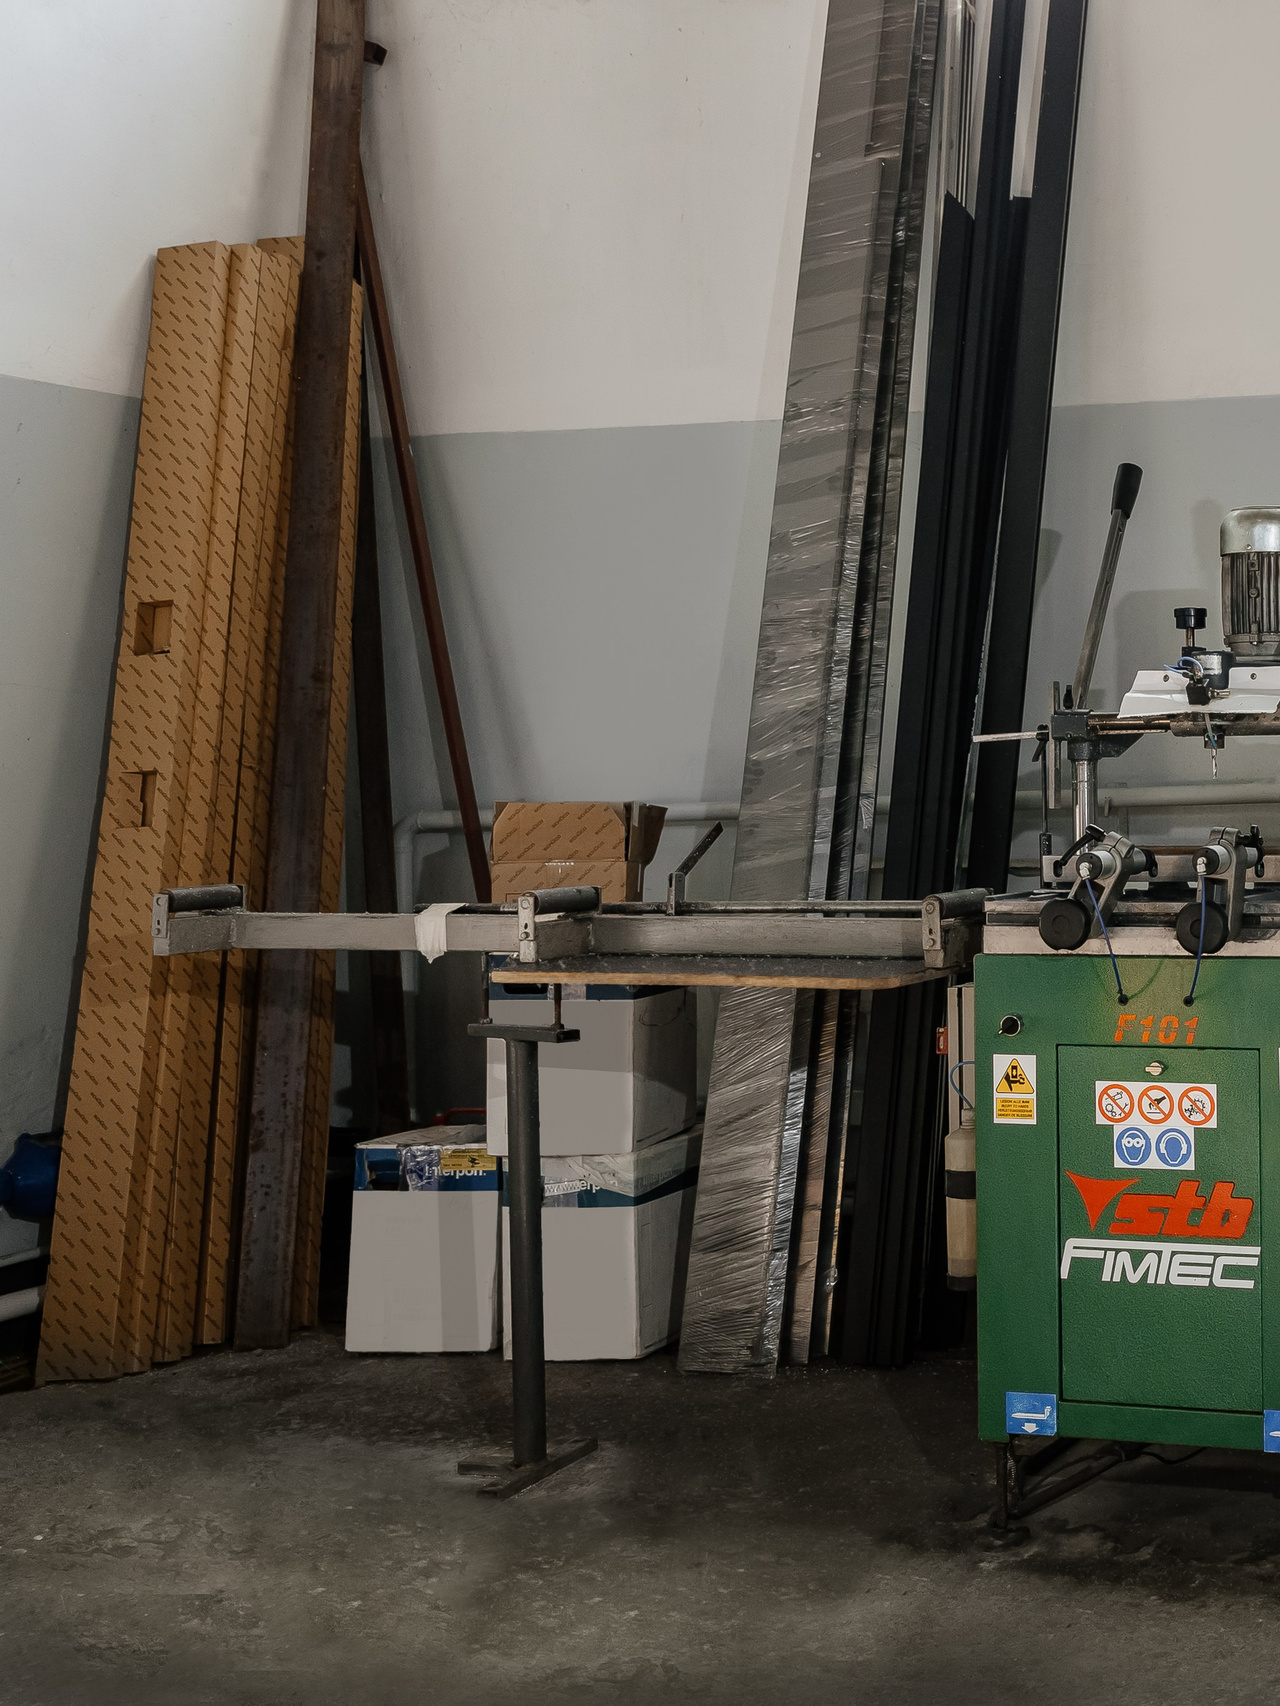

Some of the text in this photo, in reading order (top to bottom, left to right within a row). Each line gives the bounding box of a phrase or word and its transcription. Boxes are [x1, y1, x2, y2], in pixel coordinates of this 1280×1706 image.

[1113, 1014, 1199, 1045] F101
[1109, 1179, 1254, 1239] stb
[1060, 1237, 1262, 1289] FIMTEC
